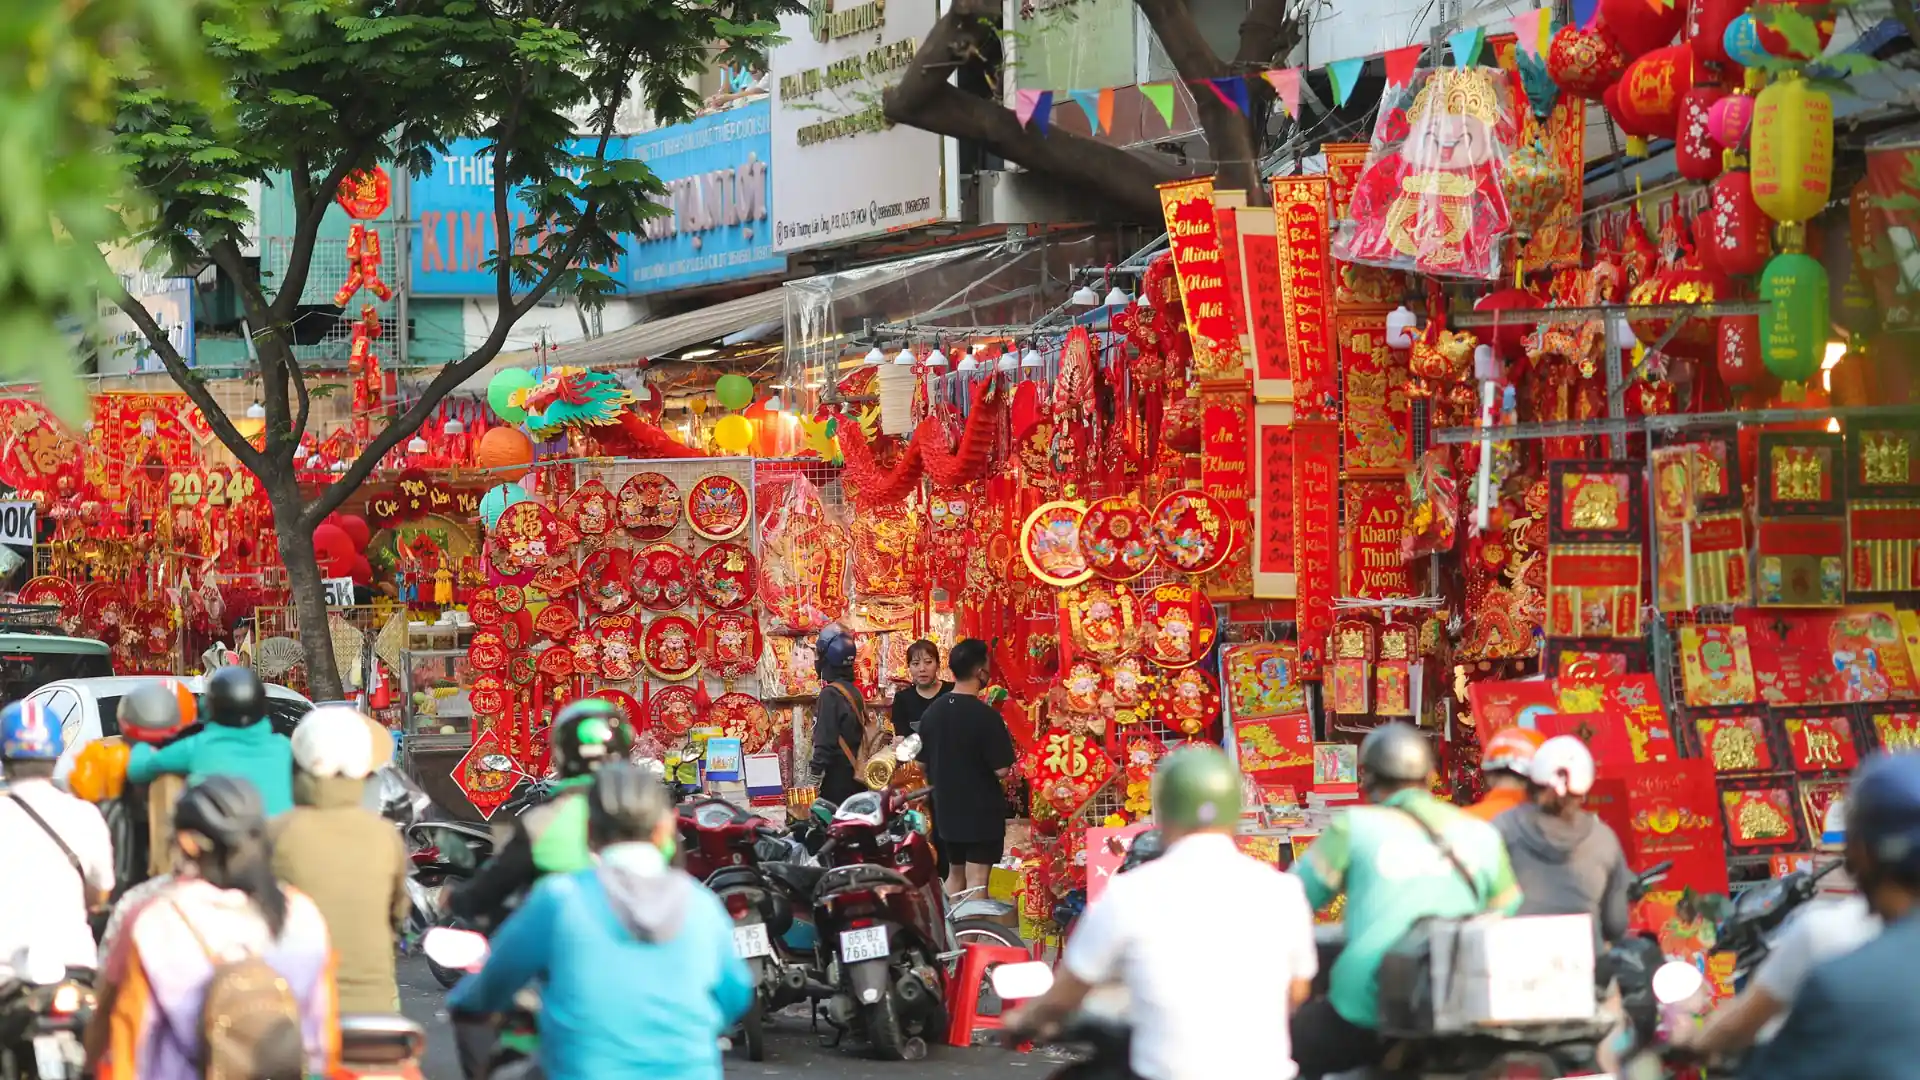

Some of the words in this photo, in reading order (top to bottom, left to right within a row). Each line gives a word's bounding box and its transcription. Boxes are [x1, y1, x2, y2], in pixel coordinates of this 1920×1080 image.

[1176, 219, 1210, 237] Chúc
[422, 211, 485, 272] KIM
[1179, 246, 1219, 264] Mừng
[1186, 274, 1223, 291] Năm
[1195, 302, 1223, 319] Mới
[1211, 427, 1234, 443] An
[1203, 456, 1245, 475] Khang
[169, 471, 245, 505] 2024
[1208, 483, 1243, 504] Thịnh
[0, 503, 36, 538] 0K
[1366, 506, 1398, 524] An
[1359, 525, 1402, 544] Khang
[1361, 546, 1402, 571] Thịnh
[1361, 569, 1408, 590] Vượng
[1045, 735, 1089, 777] 福
